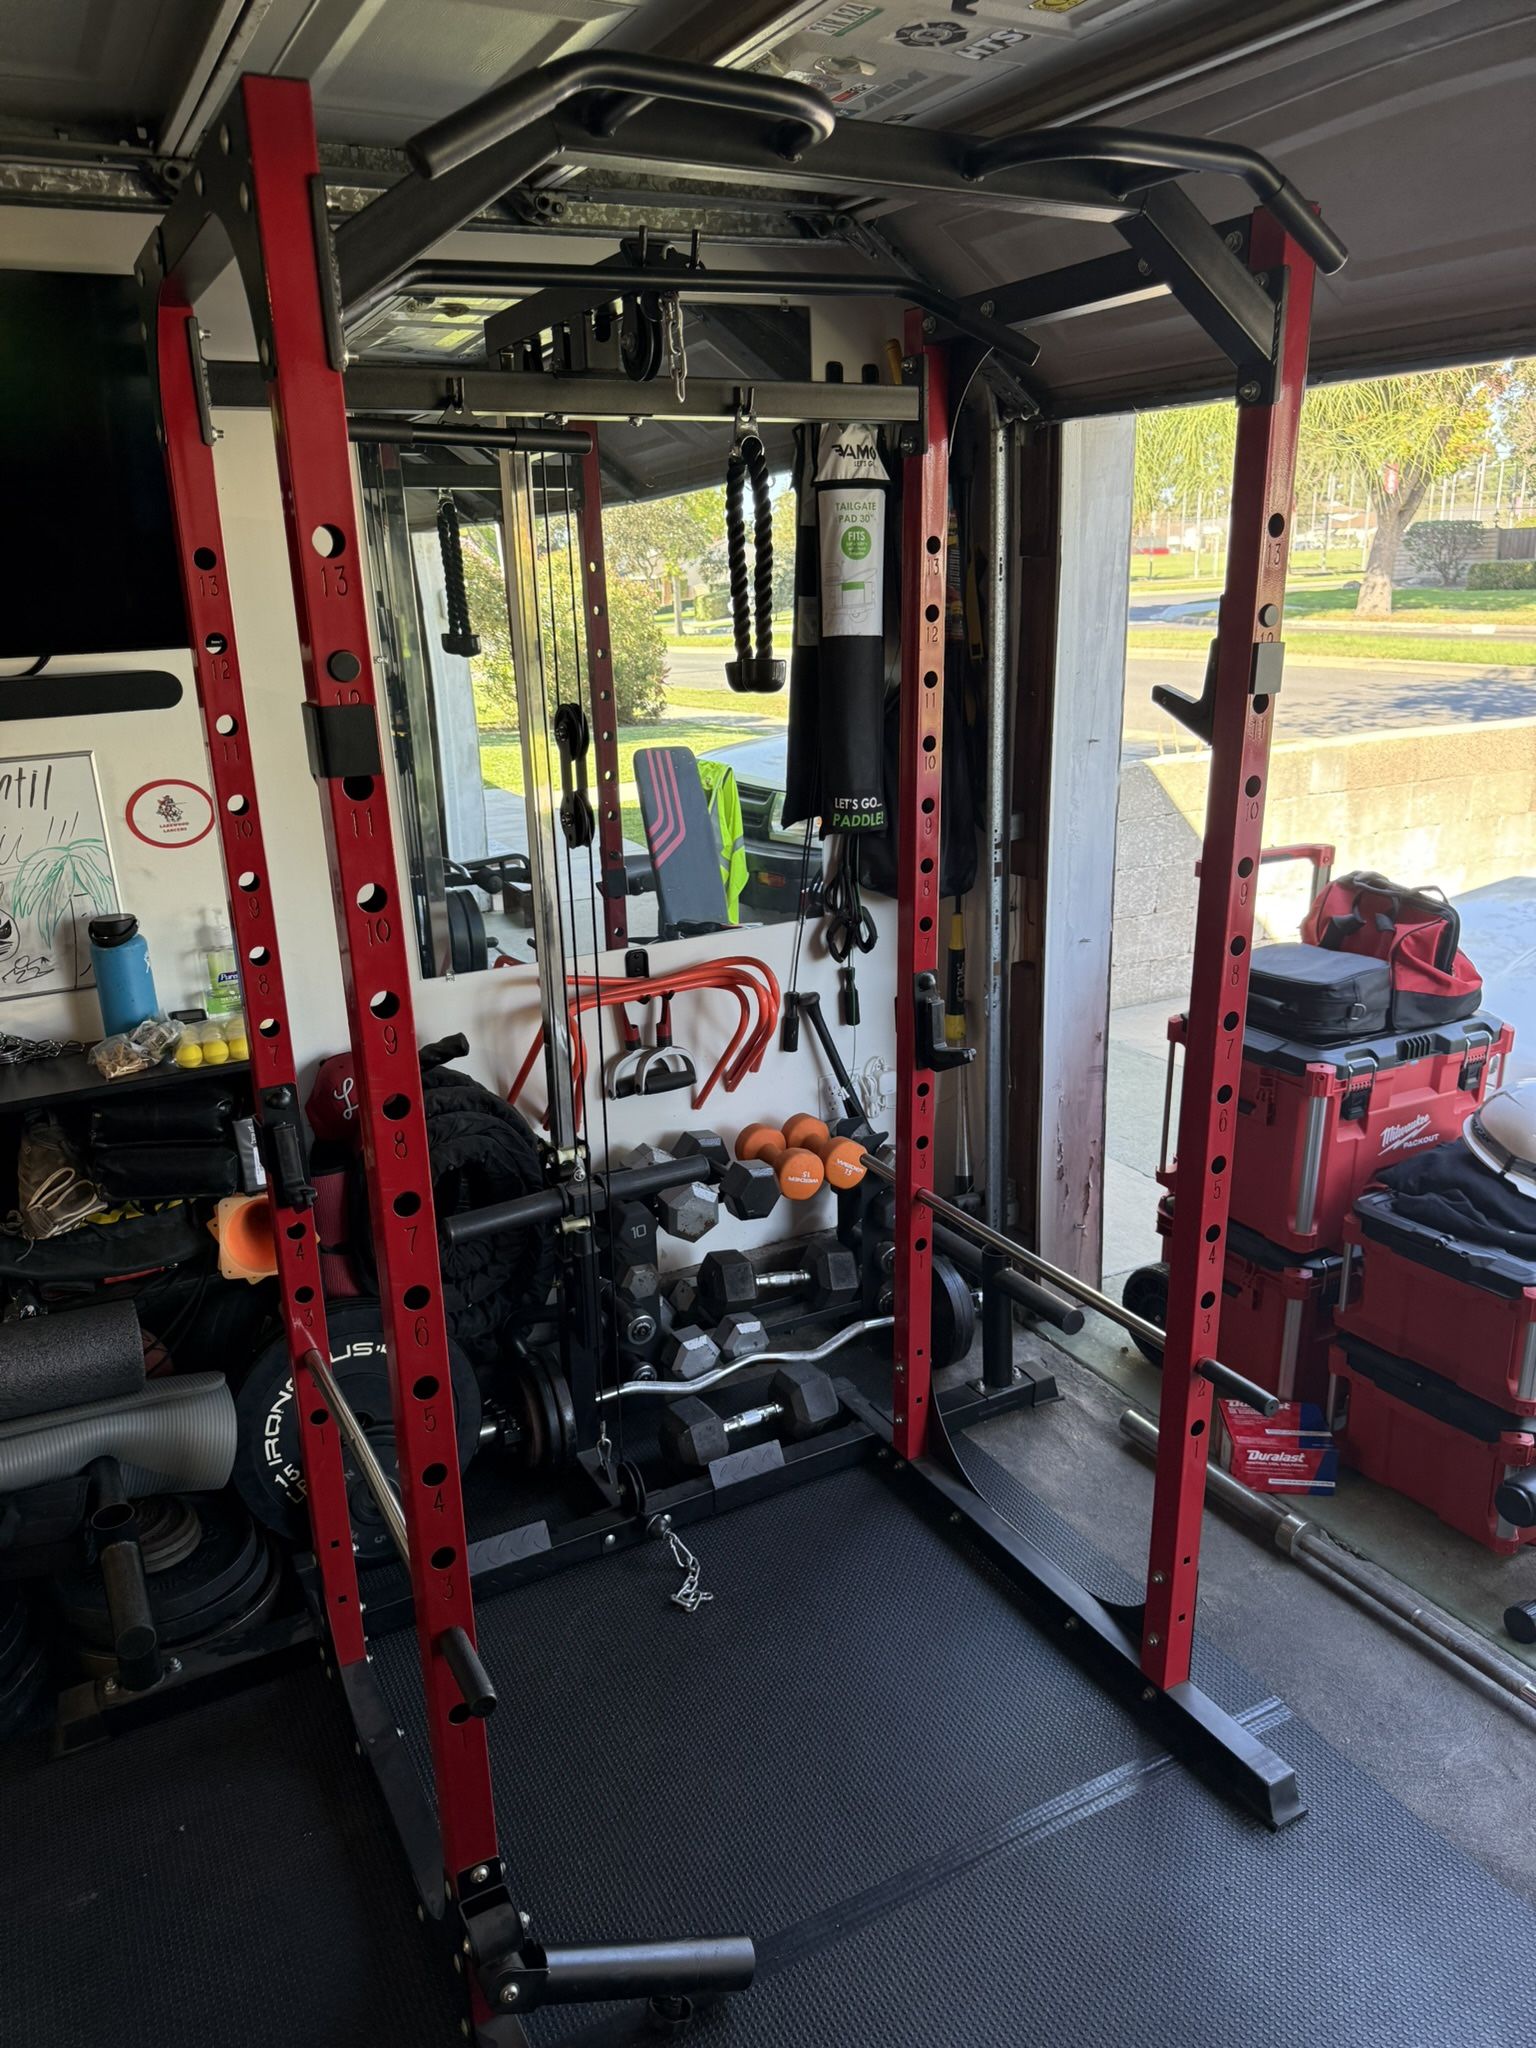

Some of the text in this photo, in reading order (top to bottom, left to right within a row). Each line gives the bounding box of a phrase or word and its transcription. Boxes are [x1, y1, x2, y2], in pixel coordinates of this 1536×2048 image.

[954, 30, 1031, 61] HTS
[865, 70, 928, 110] AEM
[835, 501, 877, 512] TAILGATE
[838, 514, 858, 524] PAD
[847, 530, 866, 542] FITS
[1266, 543, 1281, 567] 13
[926, 558, 940, 577] 13
[199, 575, 220, 597] 13
[320, 565, 349, 598] 13
[926, 625, 939, 644] 12
[211, 659, 231, 681] 12
[925, 692, 936, 709] 11
[223, 741, 240, 762] 11
[924, 755, 936, 771] 10
[834, 797, 859, 810] LET'S
[1246, 801, 1259, 822] 10
[234, 819, 254, 841] 10
[350, 806, 375, 839] 11
[832, 811, 884, 828] PADDLE!
[925, 817, 932, 836] 9
[922, 879, 931, 897] 8
[1240, 882, 1249, 906] 9
[248, 896, 261, 920] 9
[365, 917, 391, 947] 10
[921, 937, 931, 957] 7
[258, 973, 270, 996] 8
[1231, 964, 1240, 986] 8
[383, 1024, 398, 1056] 9
[1226, 1038, 1235, 1060] 7
[268, 1044, 280, 1067] 7
[919, 1099, 927, 1115] 4
[1218, 1108, 1228, 1133] 6
[1380, 1113, 1431, 1148] Milwaukee
[393, 1129, 408, 1161] 8
[1403, 1133, 1440, 1150] PACKOUT
[919, 1153, 927, 1170] 3
[1213, 1179, 1221, 1200] 5
[918, 1203, 926, 1221] 2
[403, 1225, 418, 1256] 7
[631, 1223, 647, 1240] 10
[295, 1242, 305, 1261] 4
[1208, 1244, 1216, 1265] 4
[303, 1308, 314, 1329] 3
[1202, 1314, 1212, 1335] 3
[414, 1315, 430, 1348] 6
[1197, 1378, 1206, 1398] 2
[423, 1405, 437, 1433] 5
[1246, 1449, 1305, 1463] Duralast
[274, 1463, 300, 1488] 15
[433, 1488, 445, 1514] 4
[442, 1575, 455, 1602] 3
